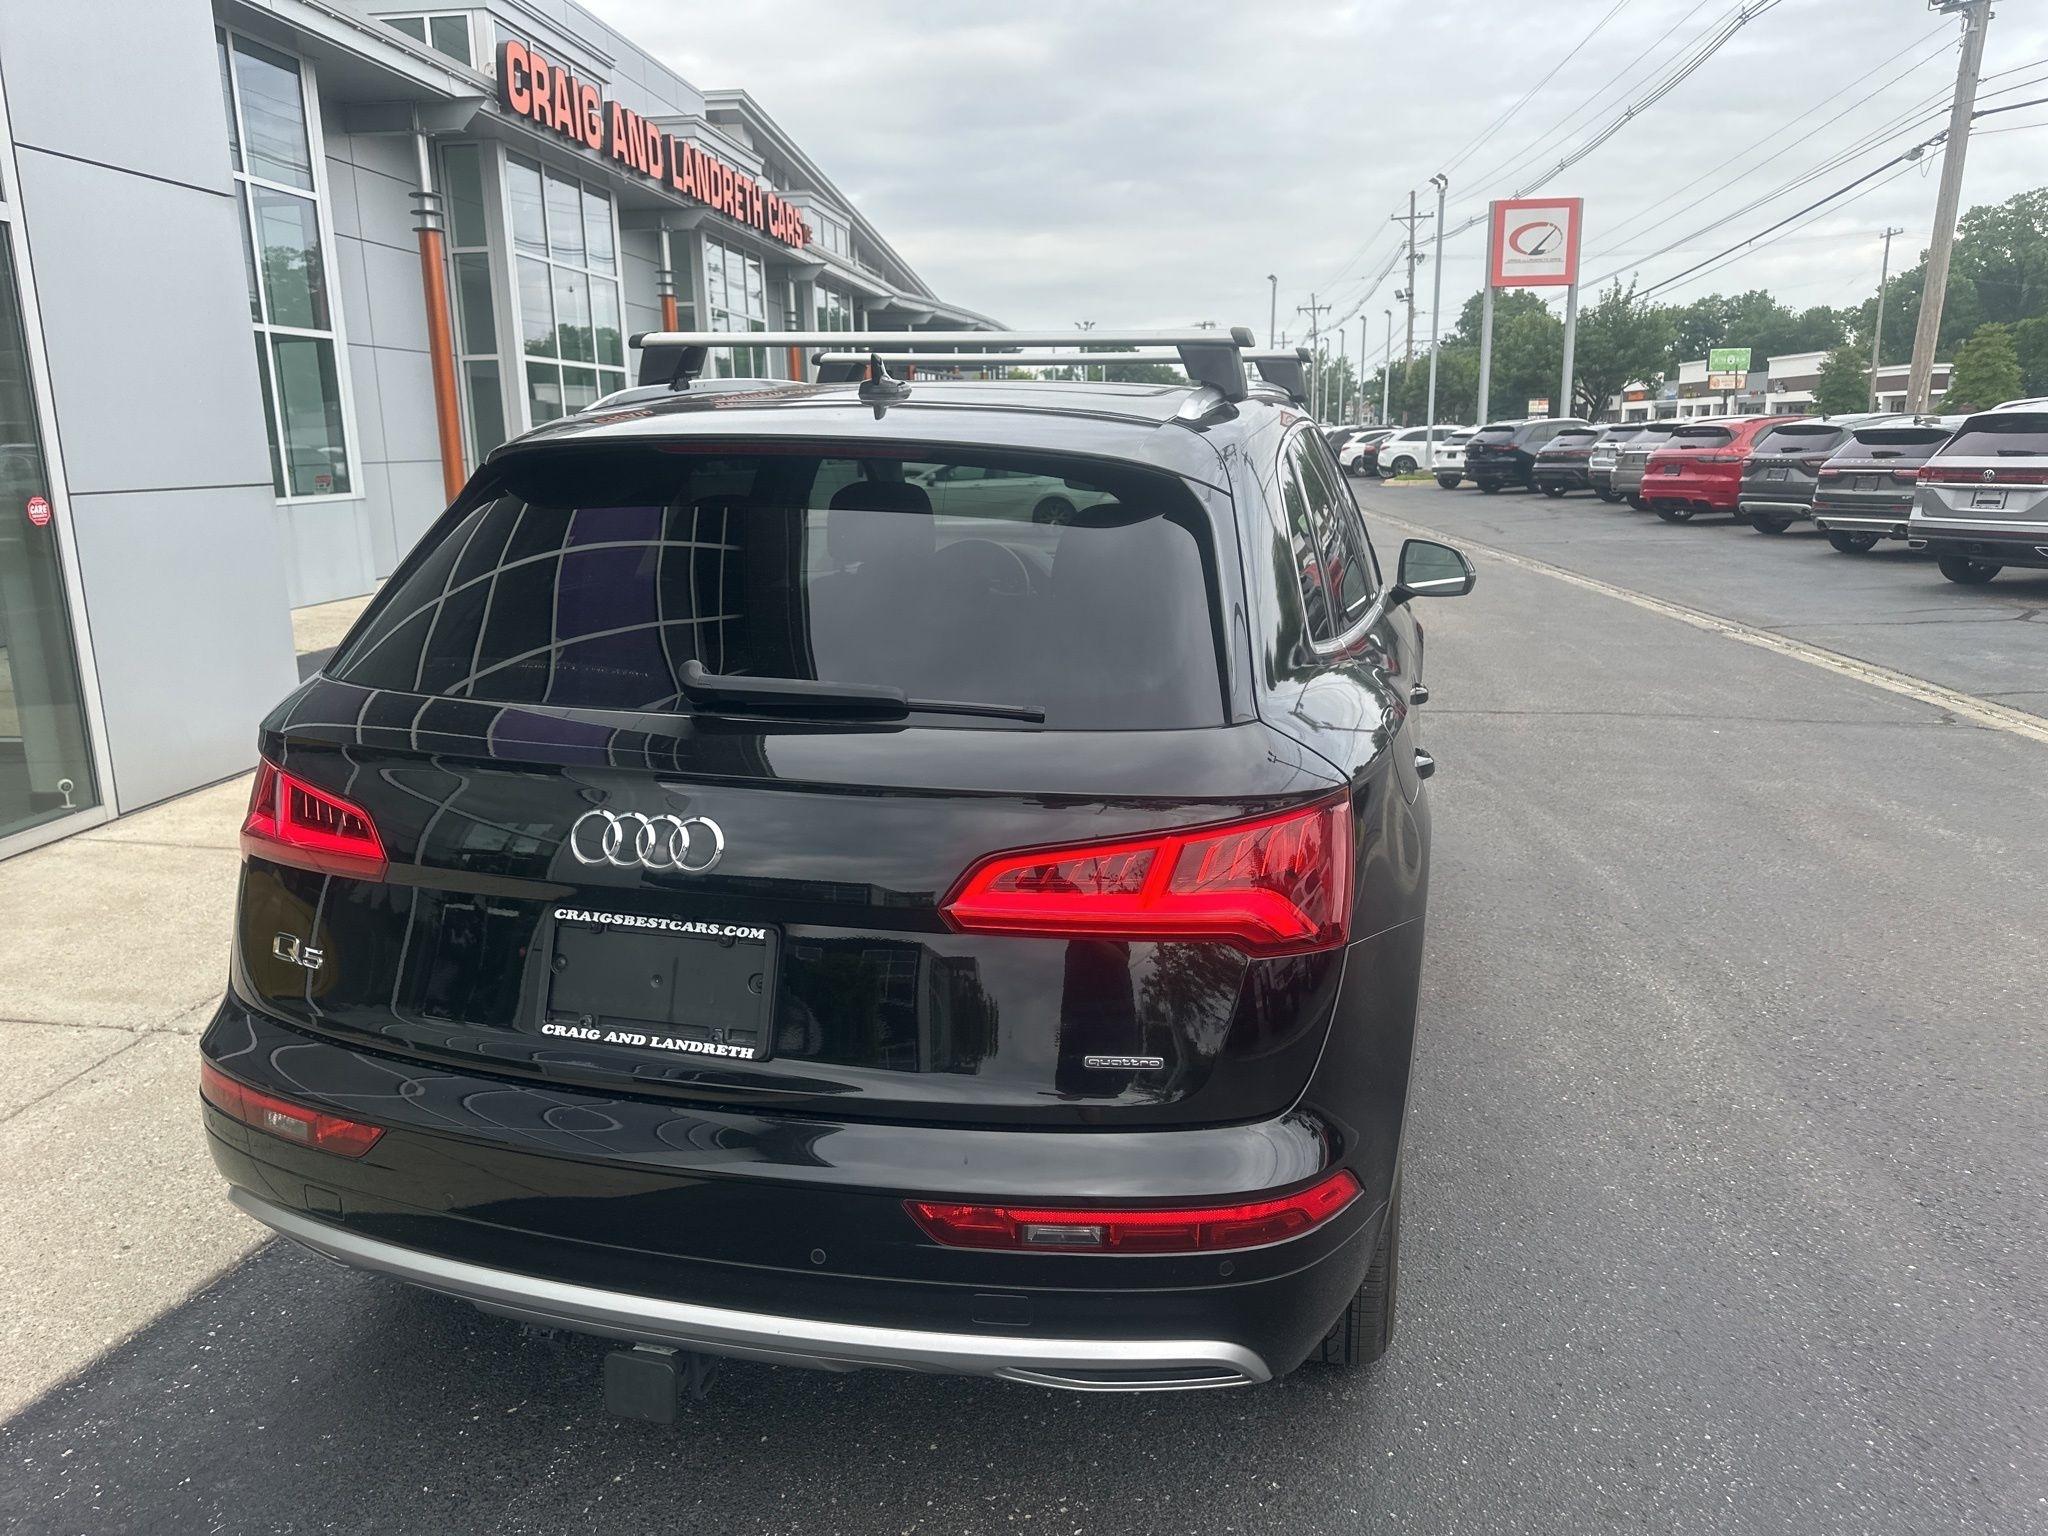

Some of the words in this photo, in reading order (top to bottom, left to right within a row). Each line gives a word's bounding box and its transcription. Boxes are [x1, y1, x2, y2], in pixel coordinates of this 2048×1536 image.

[504, 39, 601, 150] CRAIG
[611, 100, 664, 180] AND
[668, 133, 764, 231] LANDRETH
[767, 192, 804, 249] CARS
[553, 908, 767, 940] CRAIGSBESTCARS.COM
[272, 931, 324, 970] Q5
[541, 1023, 602, 1041] CRAIG
[603, 1030, 647, 1047] AND
[649, 1036, 755, 1060] LANDRETH
[1088, 1058, 1161, 1067] quattro
